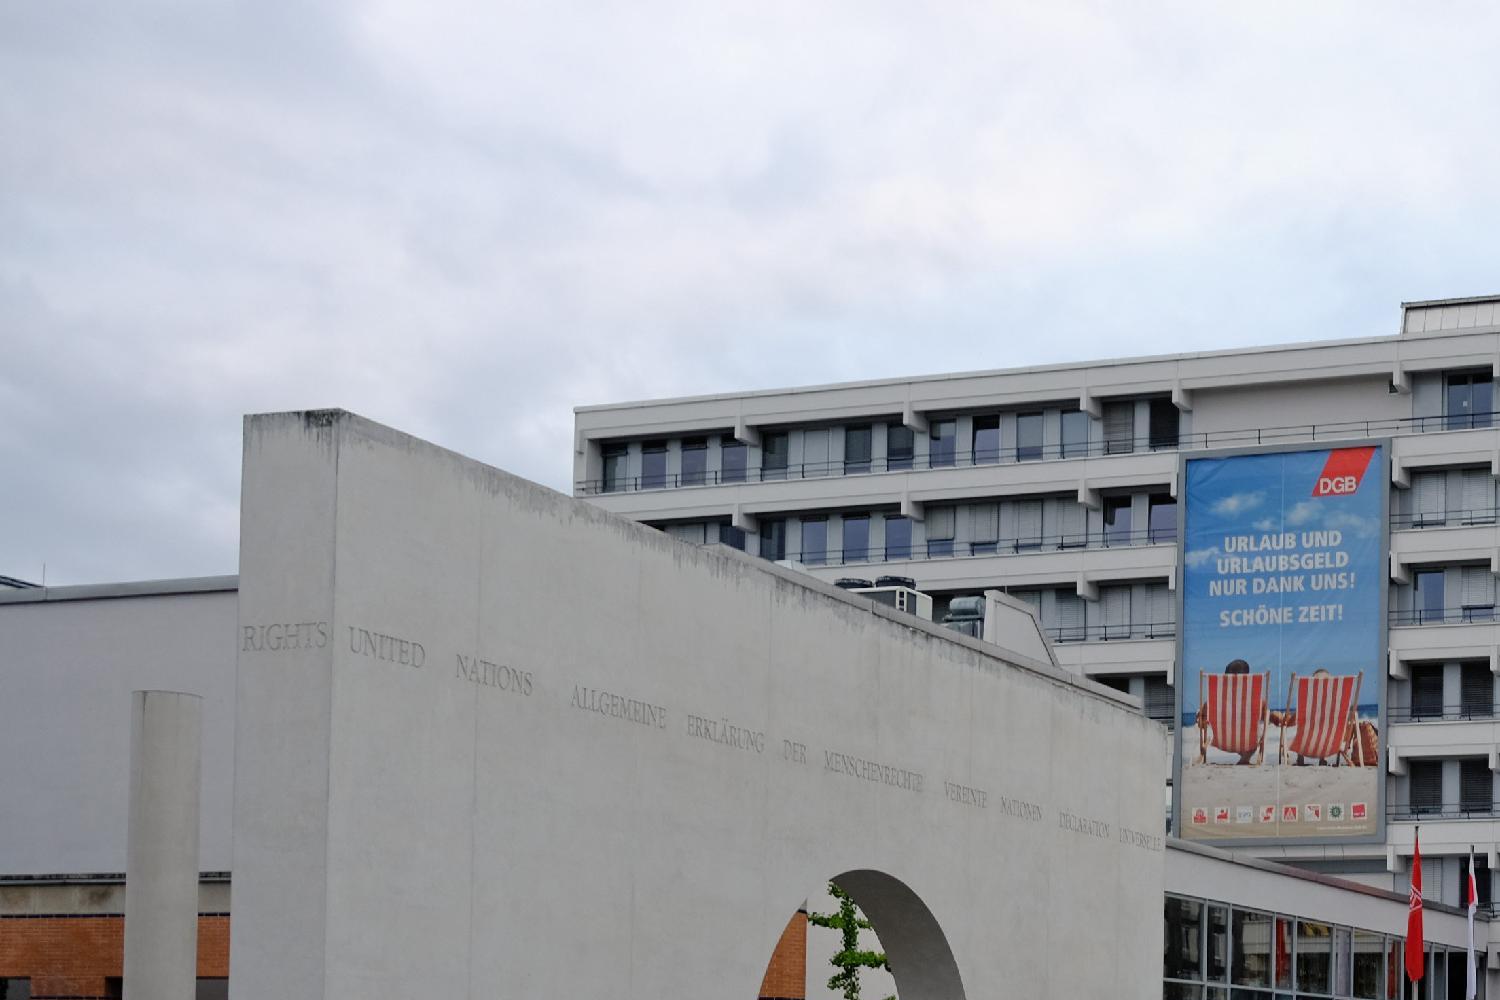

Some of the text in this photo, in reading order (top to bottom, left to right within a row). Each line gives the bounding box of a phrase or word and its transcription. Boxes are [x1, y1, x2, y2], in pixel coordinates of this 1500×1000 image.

[1319, 476, 1357, 494] DGB
[1224, 530, 1342, 552] URLAUB UND
[1217, 551, 1349, 574] URLAUBSGELD
[1209, 572, 1356, 596] NUR DANK UNS!
[1219, 604, 1343, 627] SCHÖNE ZEIT!
[241, 621, 328, 652] RIGHTS
[348, 626, 426, 668] UNITED
[456, 654, 533, 696] NATIONS
[571, 684, 667, 729] ALLGEMEINE
[687, 712, 765, 754] ERKLÄRUNG
[783, 739, 807, 765] DER
[824, 749, 923, 793] MENSCHENRECHTE
